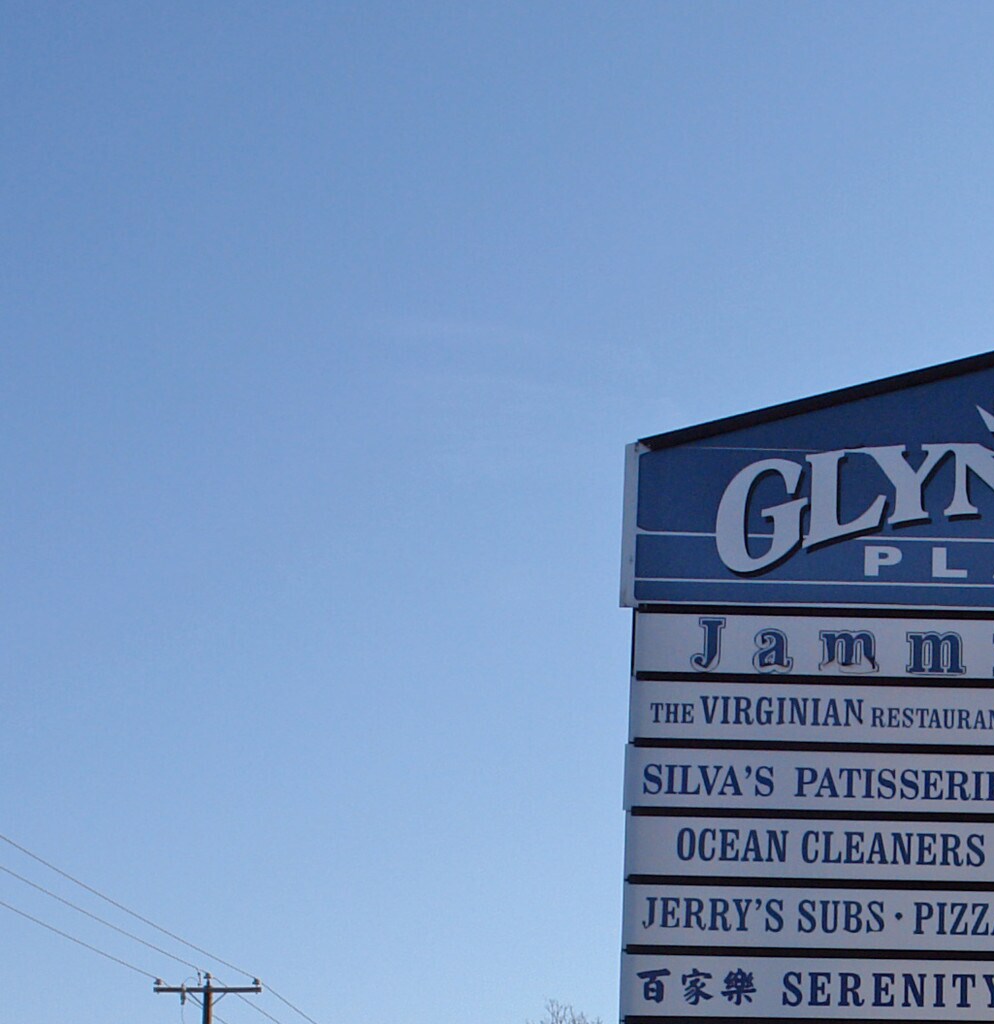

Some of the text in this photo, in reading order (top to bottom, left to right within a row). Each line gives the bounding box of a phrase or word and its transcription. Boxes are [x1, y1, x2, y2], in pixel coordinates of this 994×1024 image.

[649, 701, 694, 725] THE
[700, 696, 866, 728] VIRGINIAN
[642, 763, 776, 798] SILVA'S
[676, 827, 986, 868] OCEAN CLEANERS
[641, 896, 784, 933] JERRY'S
[797, 898, 885, 934] SUBS
[636, 967, 757, 1007] 百家樂
